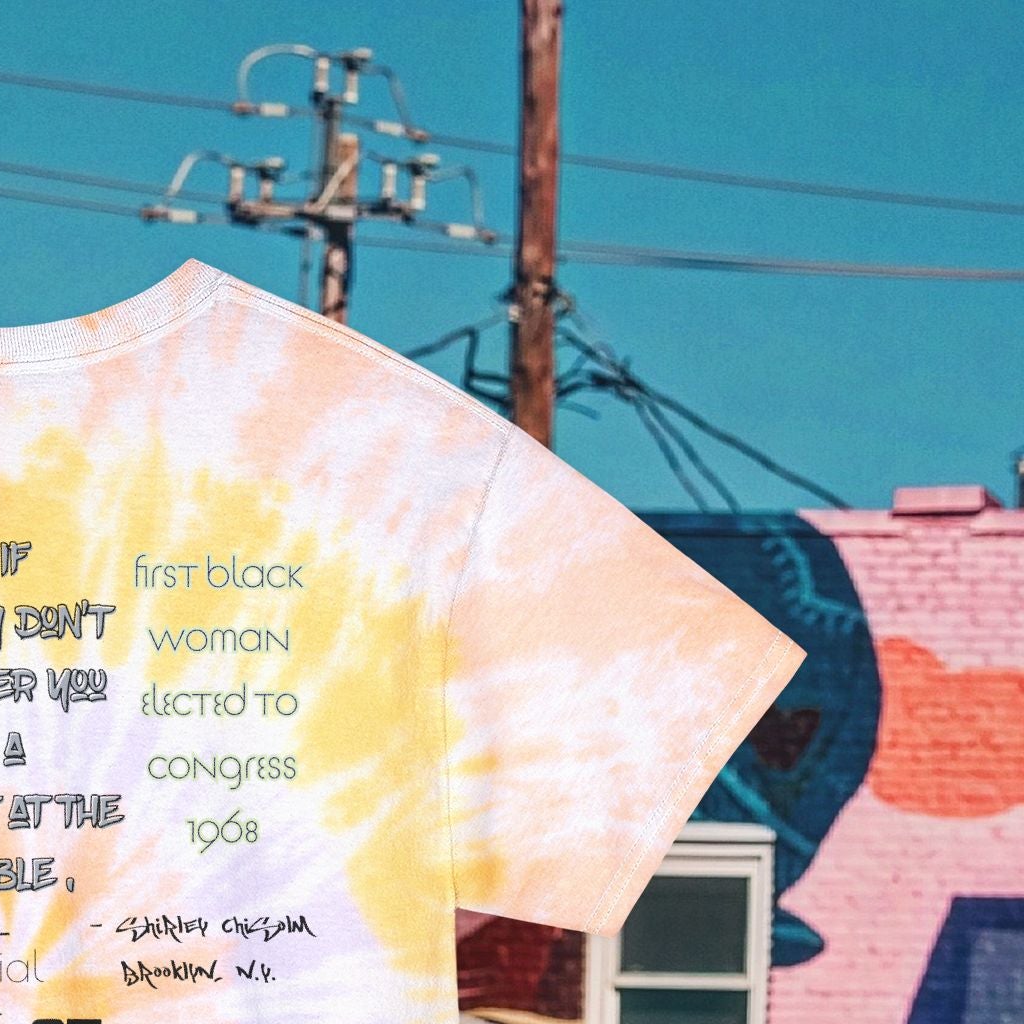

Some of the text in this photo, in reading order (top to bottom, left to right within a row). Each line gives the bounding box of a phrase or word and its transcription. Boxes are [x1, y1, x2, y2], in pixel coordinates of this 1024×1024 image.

[0, 541, 32, 577] IF
[206, 555, 304, 588] black
[14, 599, 116, 640] DON'T
[47, 668, 107, 712] YOU
[3, 732, 26, 766] A
[8, 795, 53, 829] AT
[55, 794, 125, 829] THE
[186, 810, 258, 854] 1968
